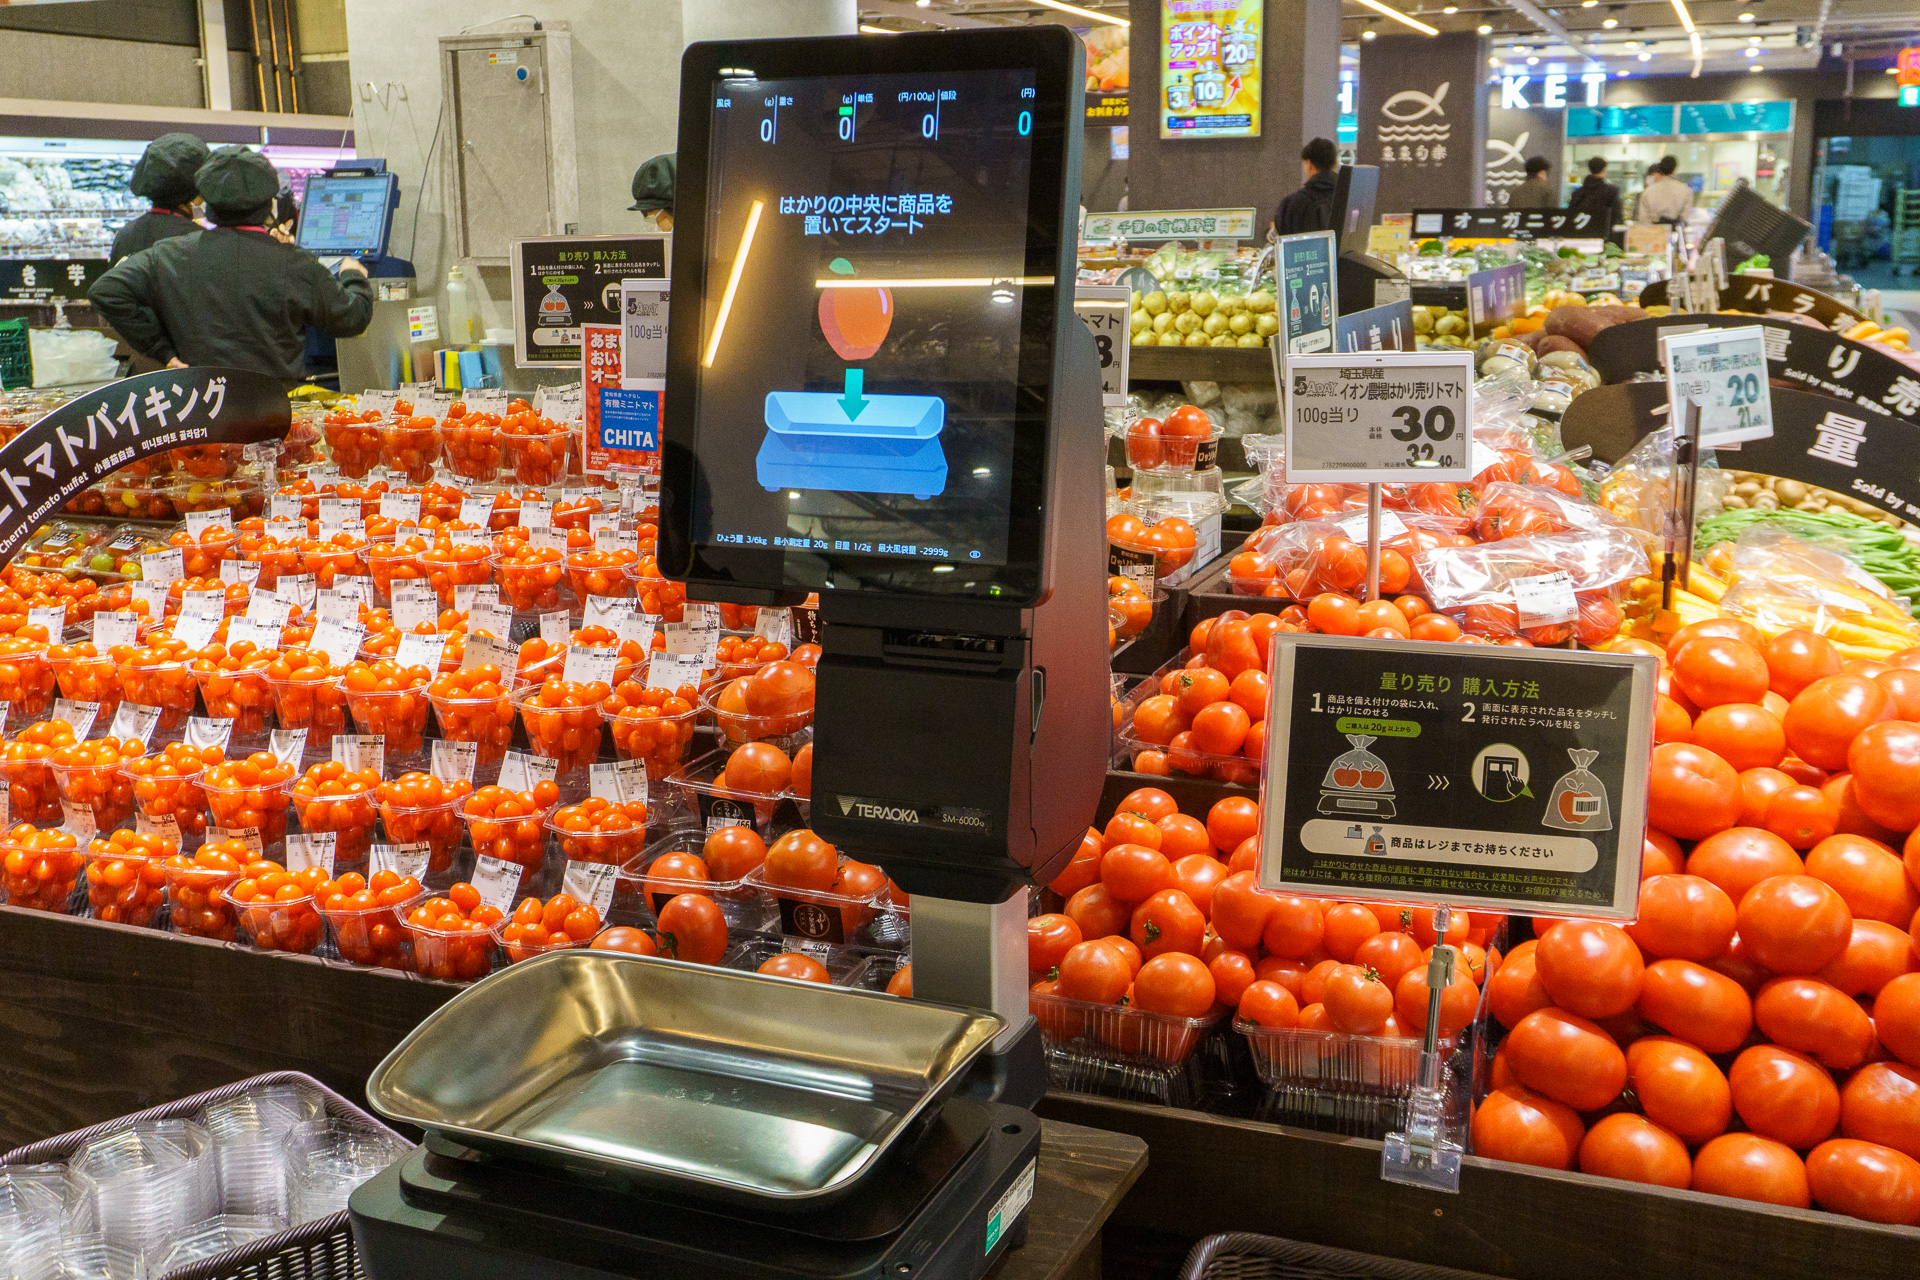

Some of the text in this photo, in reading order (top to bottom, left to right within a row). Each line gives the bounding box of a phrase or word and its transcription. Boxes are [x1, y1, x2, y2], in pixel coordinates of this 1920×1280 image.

[1169, 23, 1223, 41] ポイント
[1225, 43, 1249, 64] 20
[857, 91, 935, 103] 単価 (円/100g)
[940, 87, 1035, 101] 値段 (円)
[1171, 91, 1183, 108] 3
[1196, 81, 1218, 100] 10
[779, 96, 794, 106] 重さ
[760, 118, 772, 142] 0
[839, 116, 851, 141] 0
[922, 113, 935, 138] 0
[1018, 110, 1031, 136] 0
[779, 193, 953, 215] はかりの中央に商品を
[804, 215, 924, 236] 置いてスタート
[1117, 218, 1217, 234] 千葉の有機野菜
[1454, 212, 1592, 229] オーガニック
[558, 250, 627, 262] 量り売り 購入方法
[530, 265, 537, 276] 1
[594, 263, 602, 275] 2
[590, 332, 622, 350] あま
[590, 350, 622, 367] おい
[1112, 361, 1120, 369] 円
[590, 367, 622, 384] オー
[1339, 367, 1385, 380] 埼玉県産
[1783, 366, 1855, 399] Sold by weight
[1293, 375, 1308, 397] 5
[1339, 381, 1464, 401] イオン農場はかり売りトマト
[1727, 373, 1760, 408] 20
[604, 398, 655, 411] 有機ミニトマト
[1296, 406, 1359, 424] 100g当り
[1390, 404, 1464, 442] 30 円
[1738, 406, 1751, 429] 21
[141, 426, 209, 452] 미니토마토 골라담기
[604, 428, 654, 448] CHITA
[1806, 410, 1868, 468] 量
[1851, 478, 1906, 510] Sold by
[0, 520, 29, 554] Cherry
[27, 493, 61, 525] tomato
[60, 471, 90, 497] buffet
[716, 533, 768, 546] ひょう量 3/6kg
[773, 536, 829, 550] 最小測定量 20g
[835, 540, 872, 552] 目量 1/2g
[878, 542, 949, 558] 最大風袋量 -2999g
[706, 620, 717, 628] 249
[507, 643, 519, 652] 437
[1380, 671, 1541, 700] 量り売り 購入方法
[1310, 692, 1324, 713] 1
[1327, 694, 1440, 712] 商品を備え付けの袋に入れ、
[1327, 706, 1390, 717] はかりにのせる
[1482, 702, 1618, 721] 画面に表示された品名をタッチし
[1461, 702, 1476, 723] 2
[1371, 723, 1387, 734] 20g
[1481, 714, 1582, 730] 発行されたラベルを貼る
[544, 758, 556, 767] 401
[856, 803, 920, 824] TERAOKA
[735, 820, 751, 830] 466
[1390, 836, 1555, 859] 商品はレジまでお持ちください
